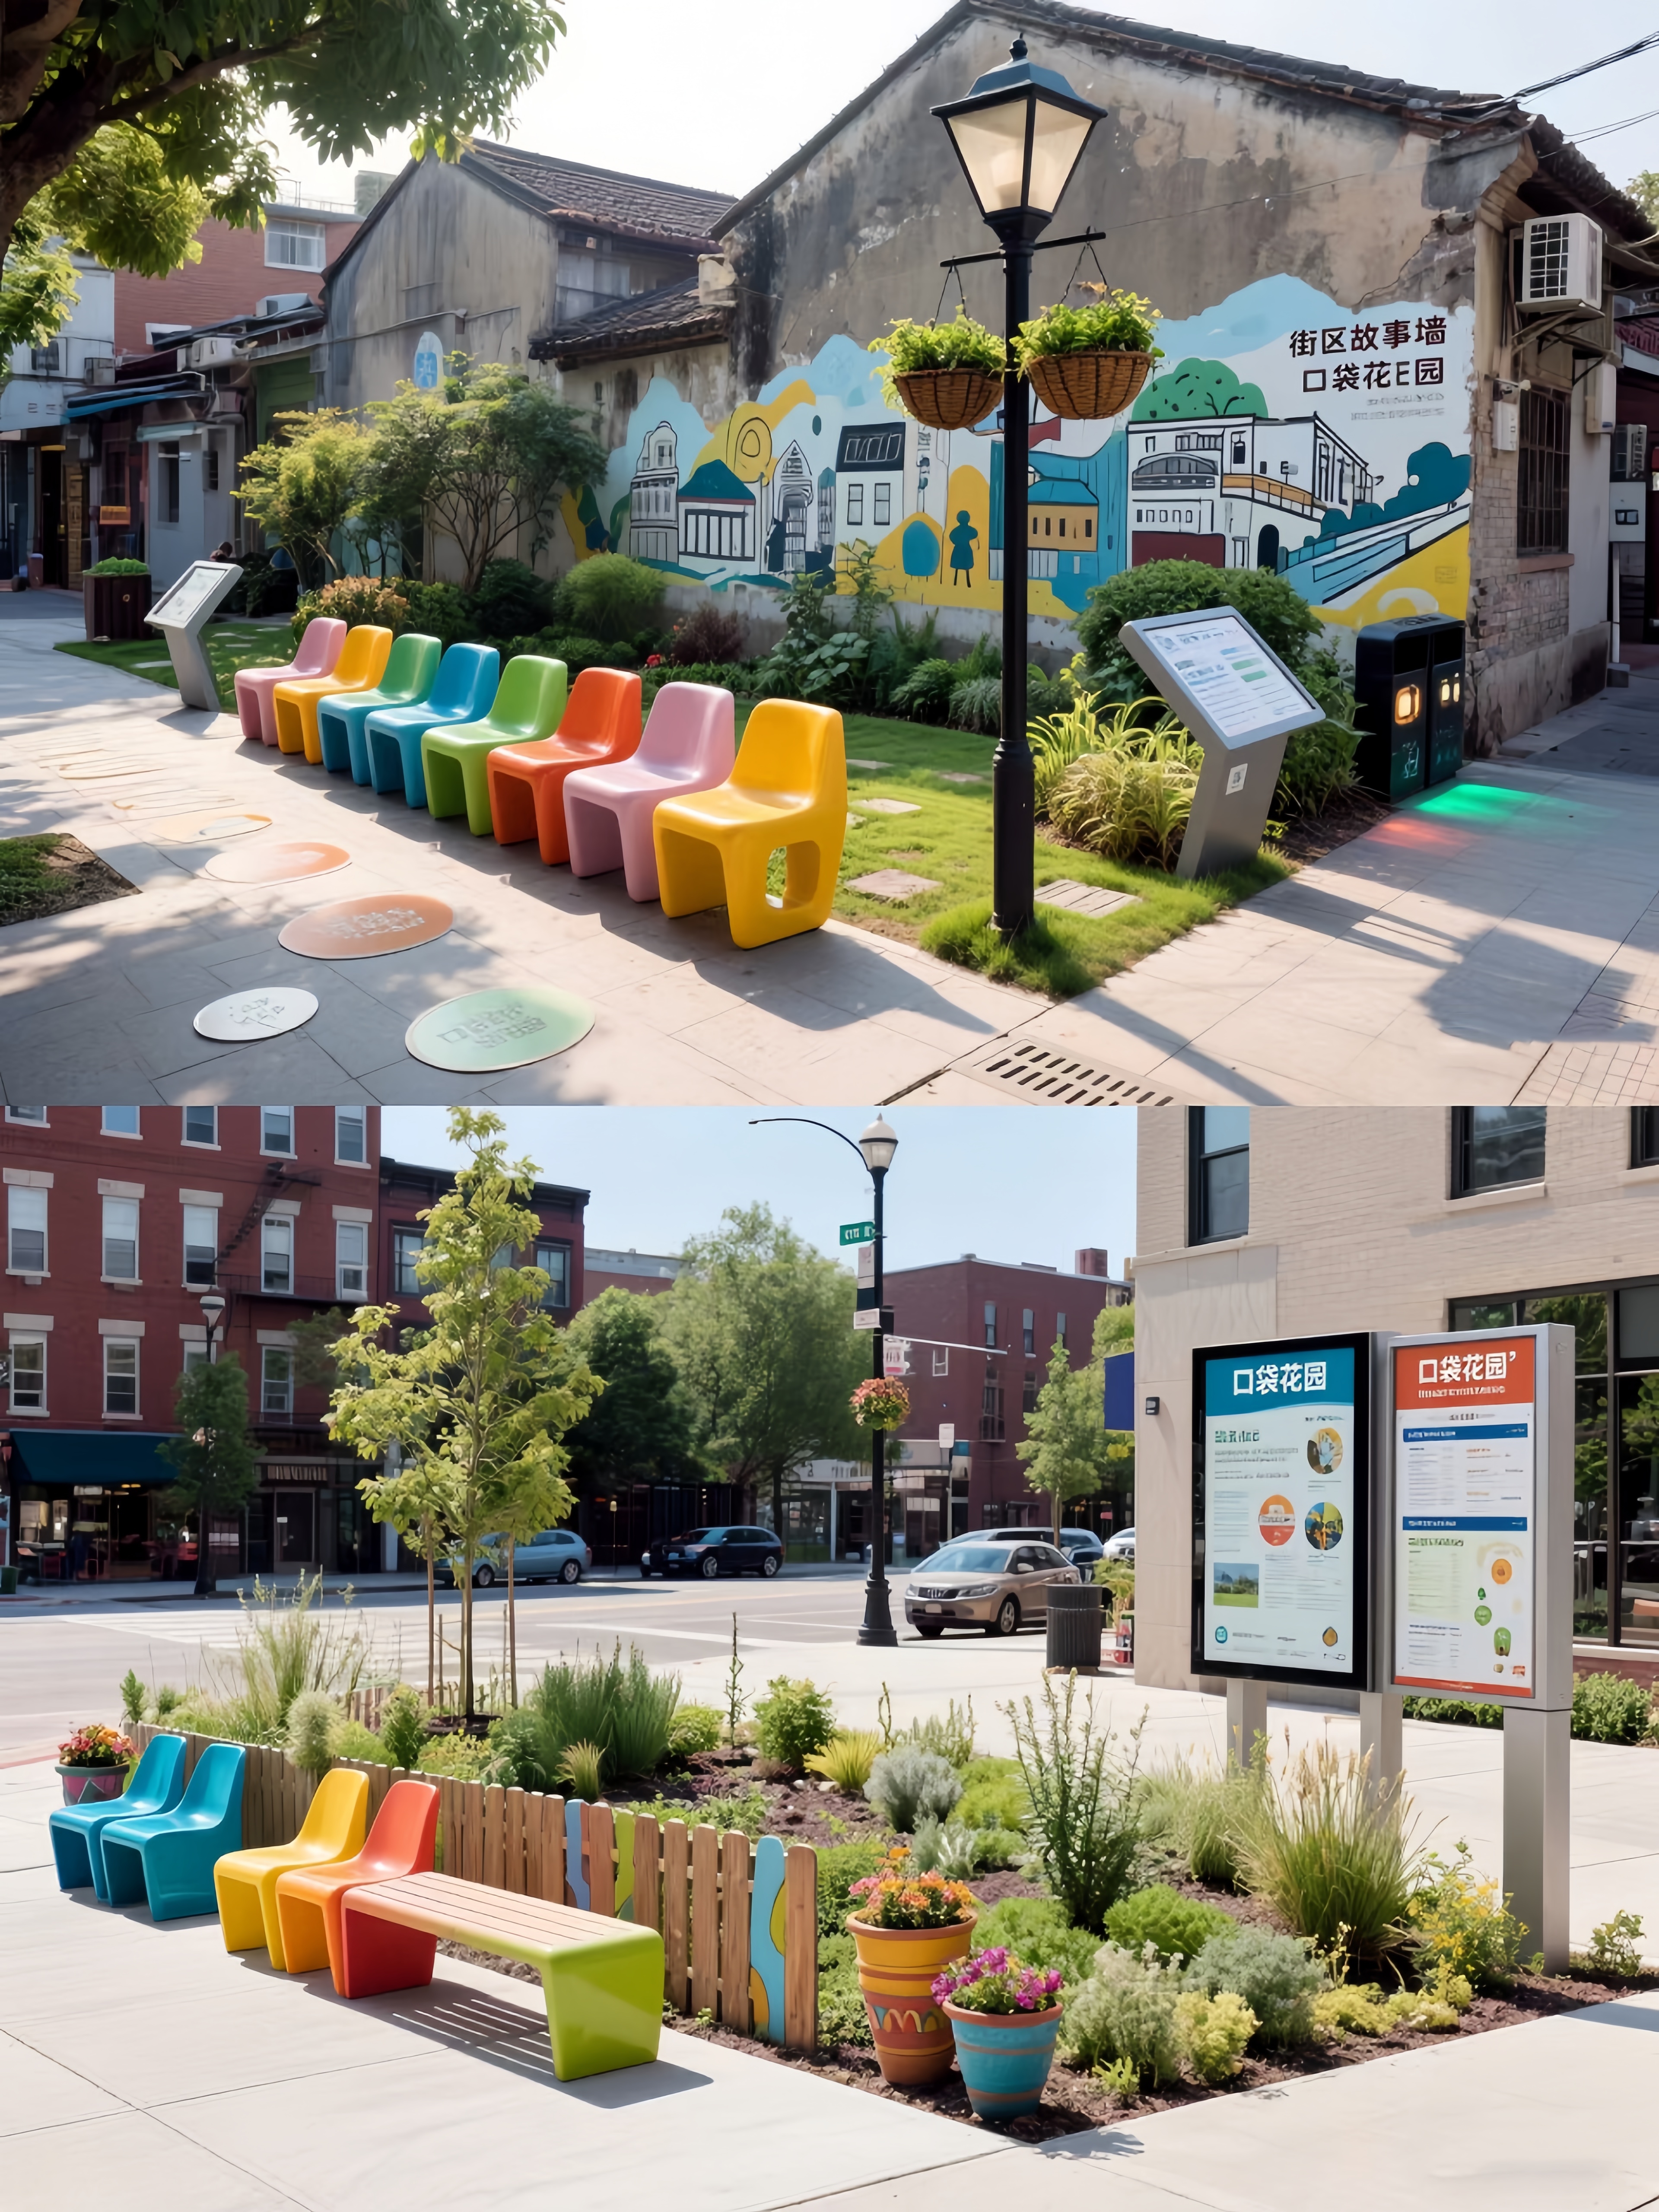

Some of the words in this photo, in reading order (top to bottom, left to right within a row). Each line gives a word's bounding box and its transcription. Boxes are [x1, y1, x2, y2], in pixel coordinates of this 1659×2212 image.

[1289, 315, 1446, 357] 街区故事墙
[1233, 1361, 1326, 1395] 口袋花园
